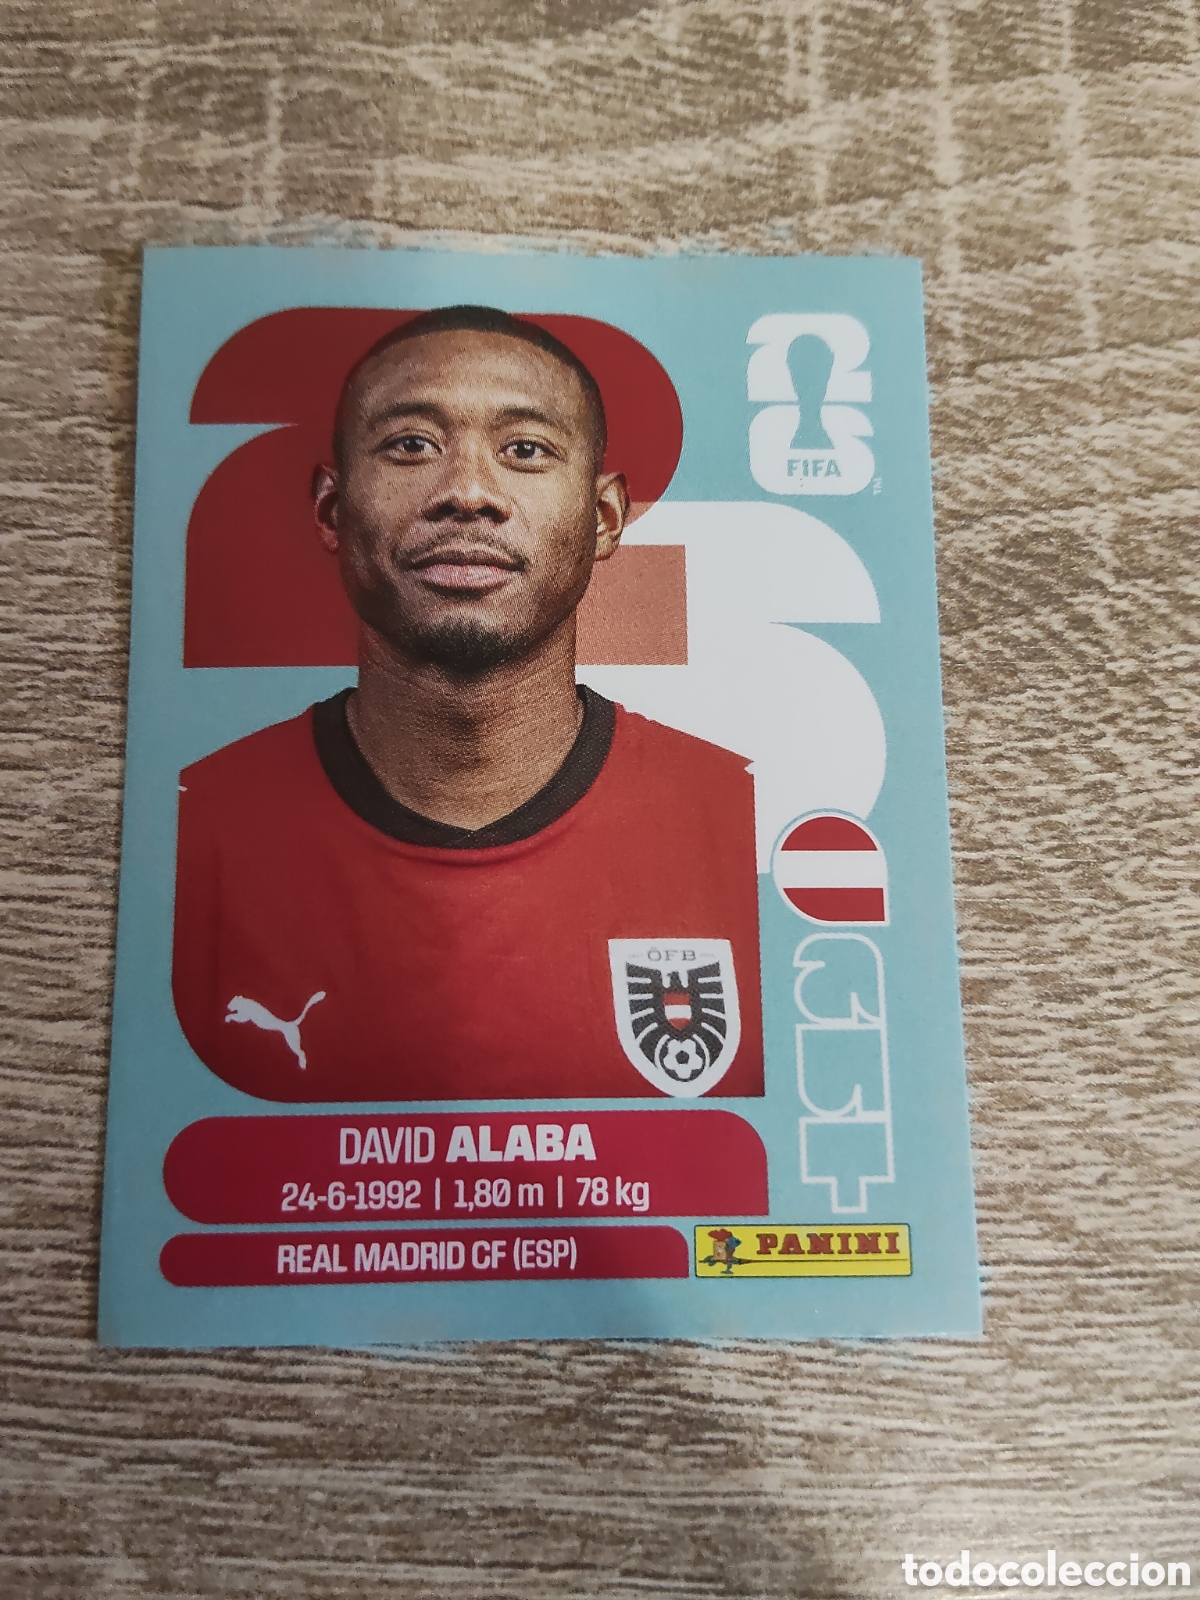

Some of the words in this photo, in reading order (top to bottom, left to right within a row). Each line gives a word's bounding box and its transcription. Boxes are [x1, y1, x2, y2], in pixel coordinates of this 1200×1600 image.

[786, 458, 842, 478] FIFA
[647, 946, 697, 961] ÖFB
[339, 1126, 435, 1165] DAVID
[445, 1123, 598, 1163] ALABA
[280, 1179, 422, 1212] 24-6-1992
[453, 1177, 512, 1212] 1,80
[517, 1182, 544, 1208] m
[575, 1176, 609, 1207] 78
[615, 1175, 651, 1212] kg
[276, 1243, 348, 1274] REAL
[354, 1241, 465, 1273] MADRID
[471, 1240, 507, 1271] CF
[513, 1236, 578, 1271] (ESP)
[756, 1231, 901, 1255] PANINI
